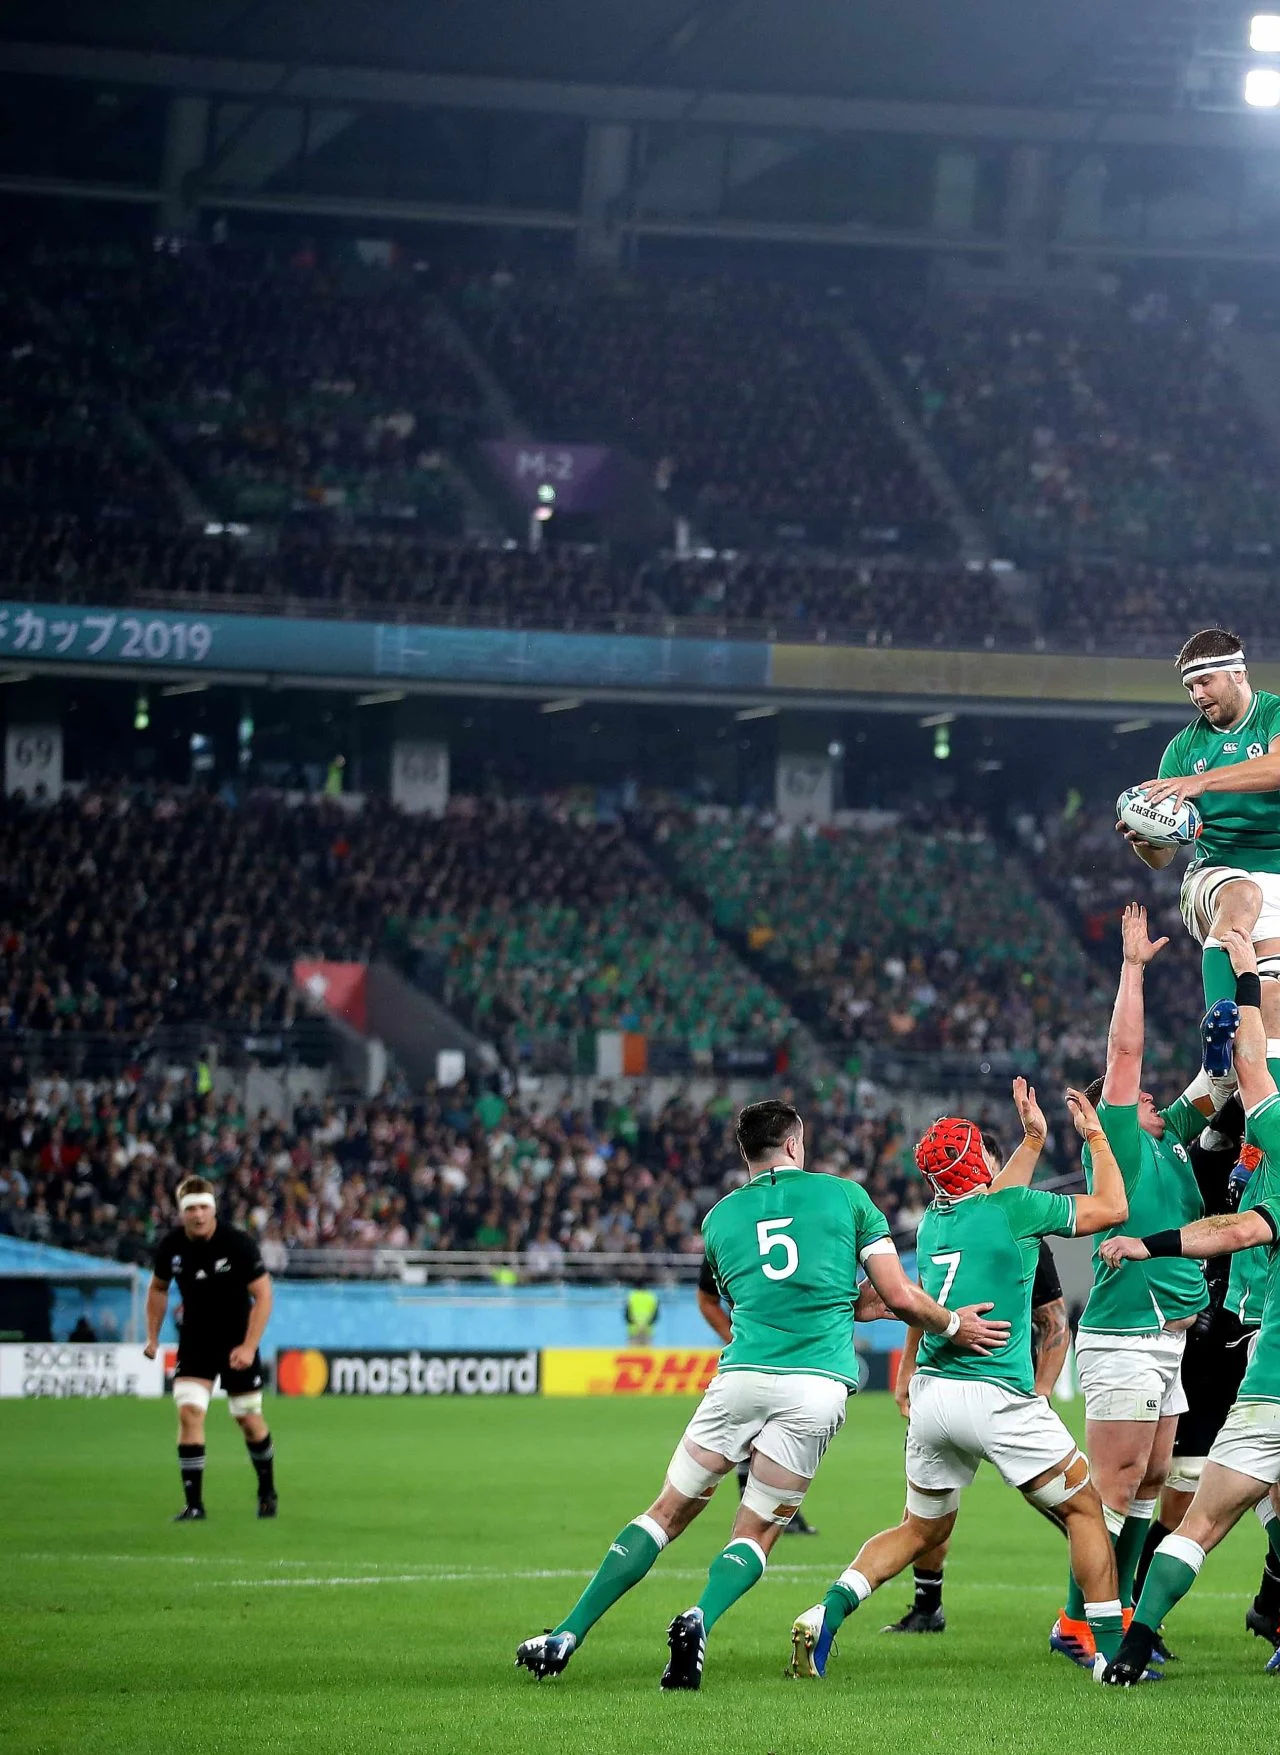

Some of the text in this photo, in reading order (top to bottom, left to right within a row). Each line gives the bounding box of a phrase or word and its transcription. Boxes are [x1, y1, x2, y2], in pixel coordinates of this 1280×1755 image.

[1129, 803, 1177, 827] GILBERT
[756, 1217, 799, 1281] 5
[931, 1252, 962, 1307] 7
[331, 1350, 538, 1395] mastercard
